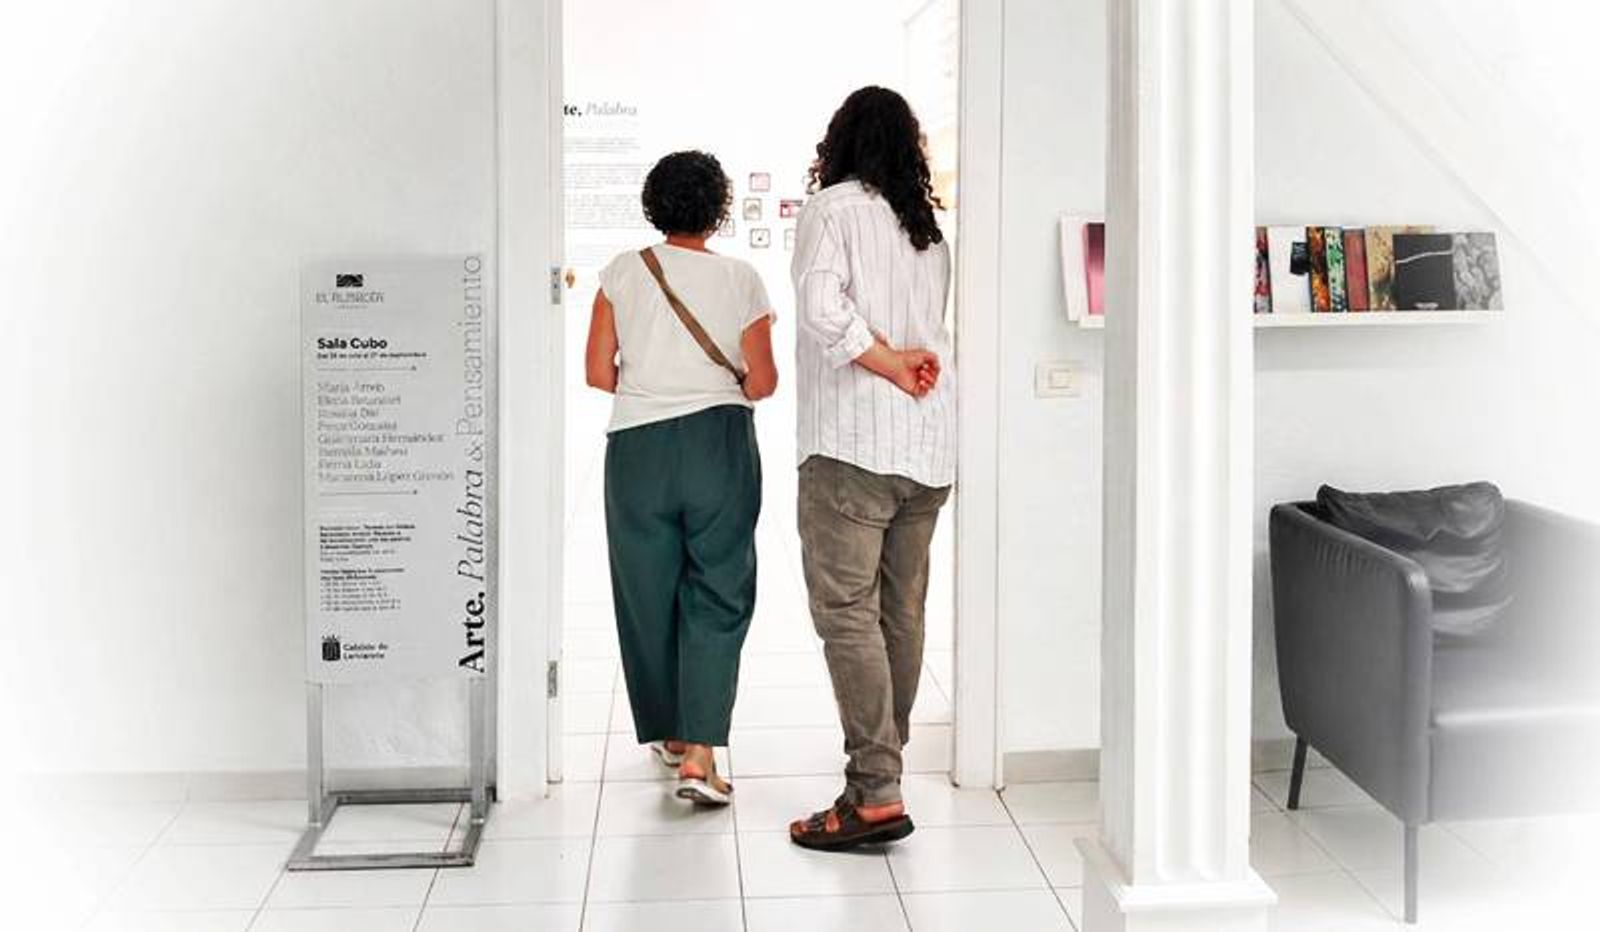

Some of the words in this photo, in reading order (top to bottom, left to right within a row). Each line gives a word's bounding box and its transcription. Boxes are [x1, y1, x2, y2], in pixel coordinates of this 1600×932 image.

[317, 338, 347, 349] Sala
[350, 338, 387, 349] Cubo
[456, 256, 484, 436] Pensamiento
[466, 438, 483, 462] &
[457, 469, 484, 582] Palabra
[459, 592, 485, 673] Arte.
